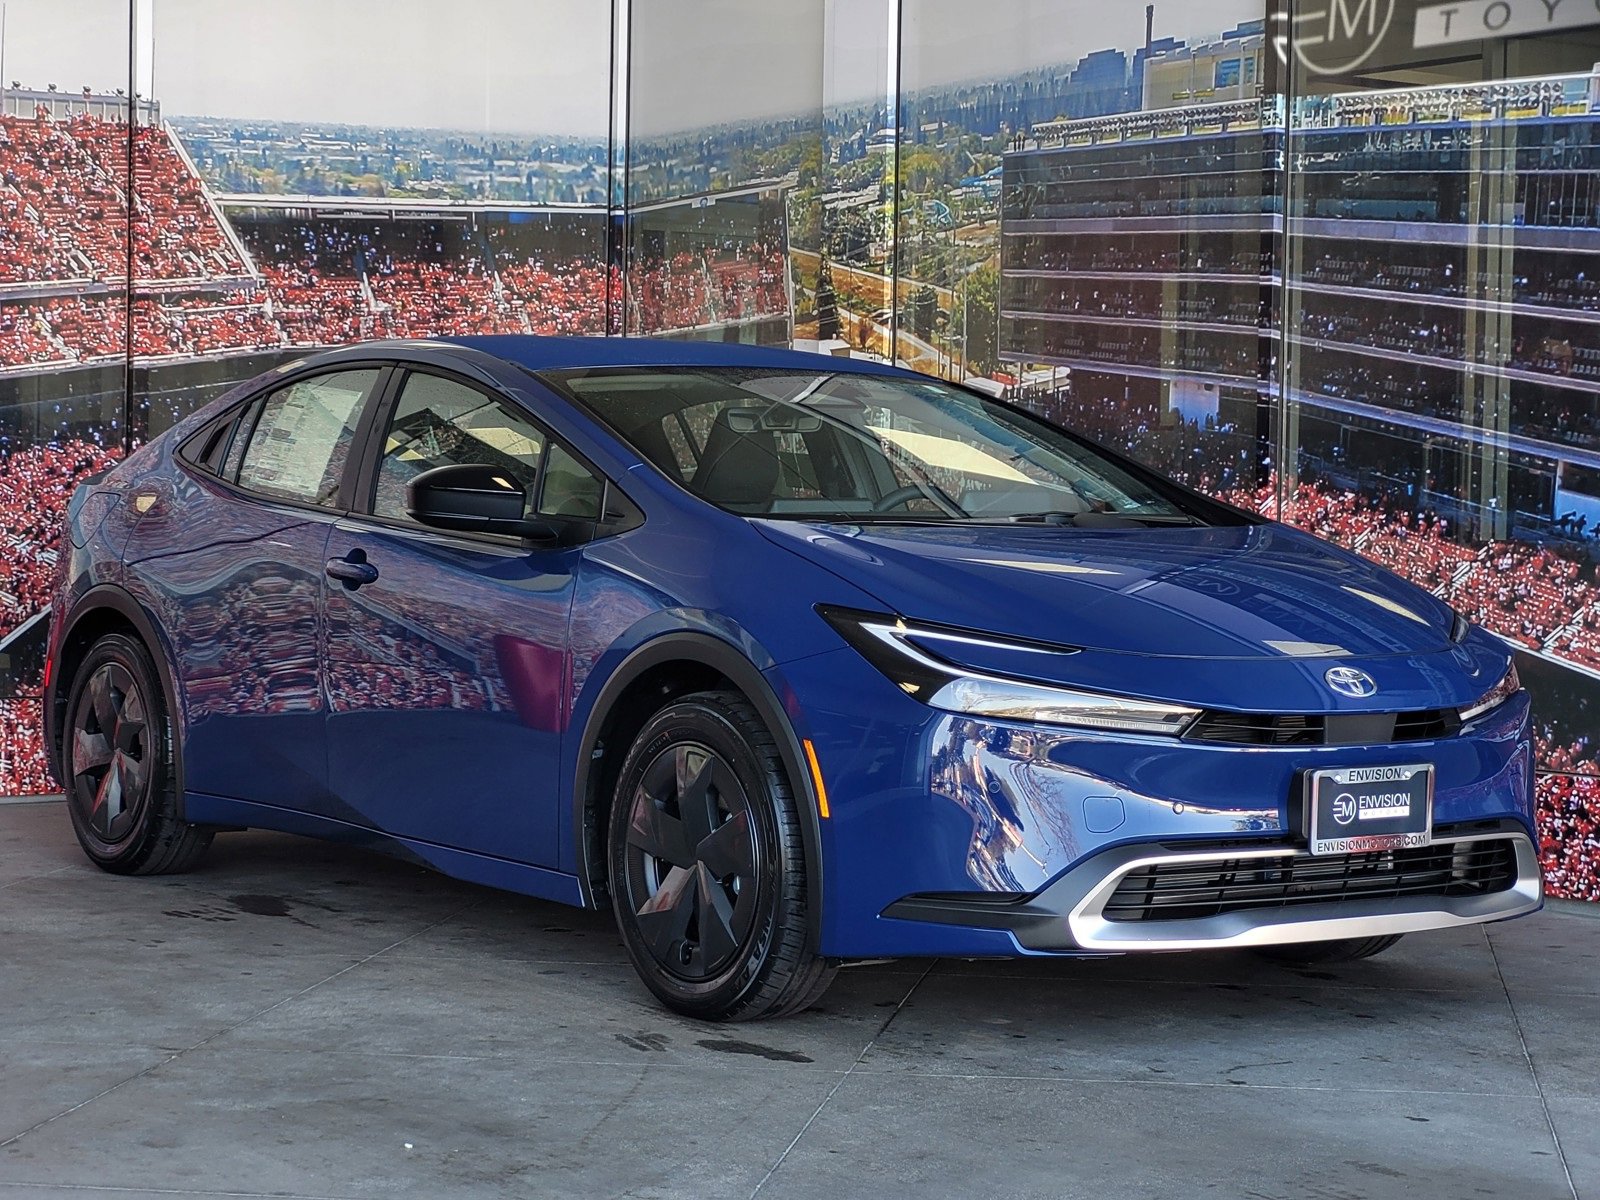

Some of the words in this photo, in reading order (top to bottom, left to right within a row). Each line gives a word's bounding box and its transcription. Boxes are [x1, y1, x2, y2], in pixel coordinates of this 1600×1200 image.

[1440, 0, 1600, 37] TOY
[1348, 768, 1402, 782] ENVISION
[1359, 793, 1410, 808] ENVISION
